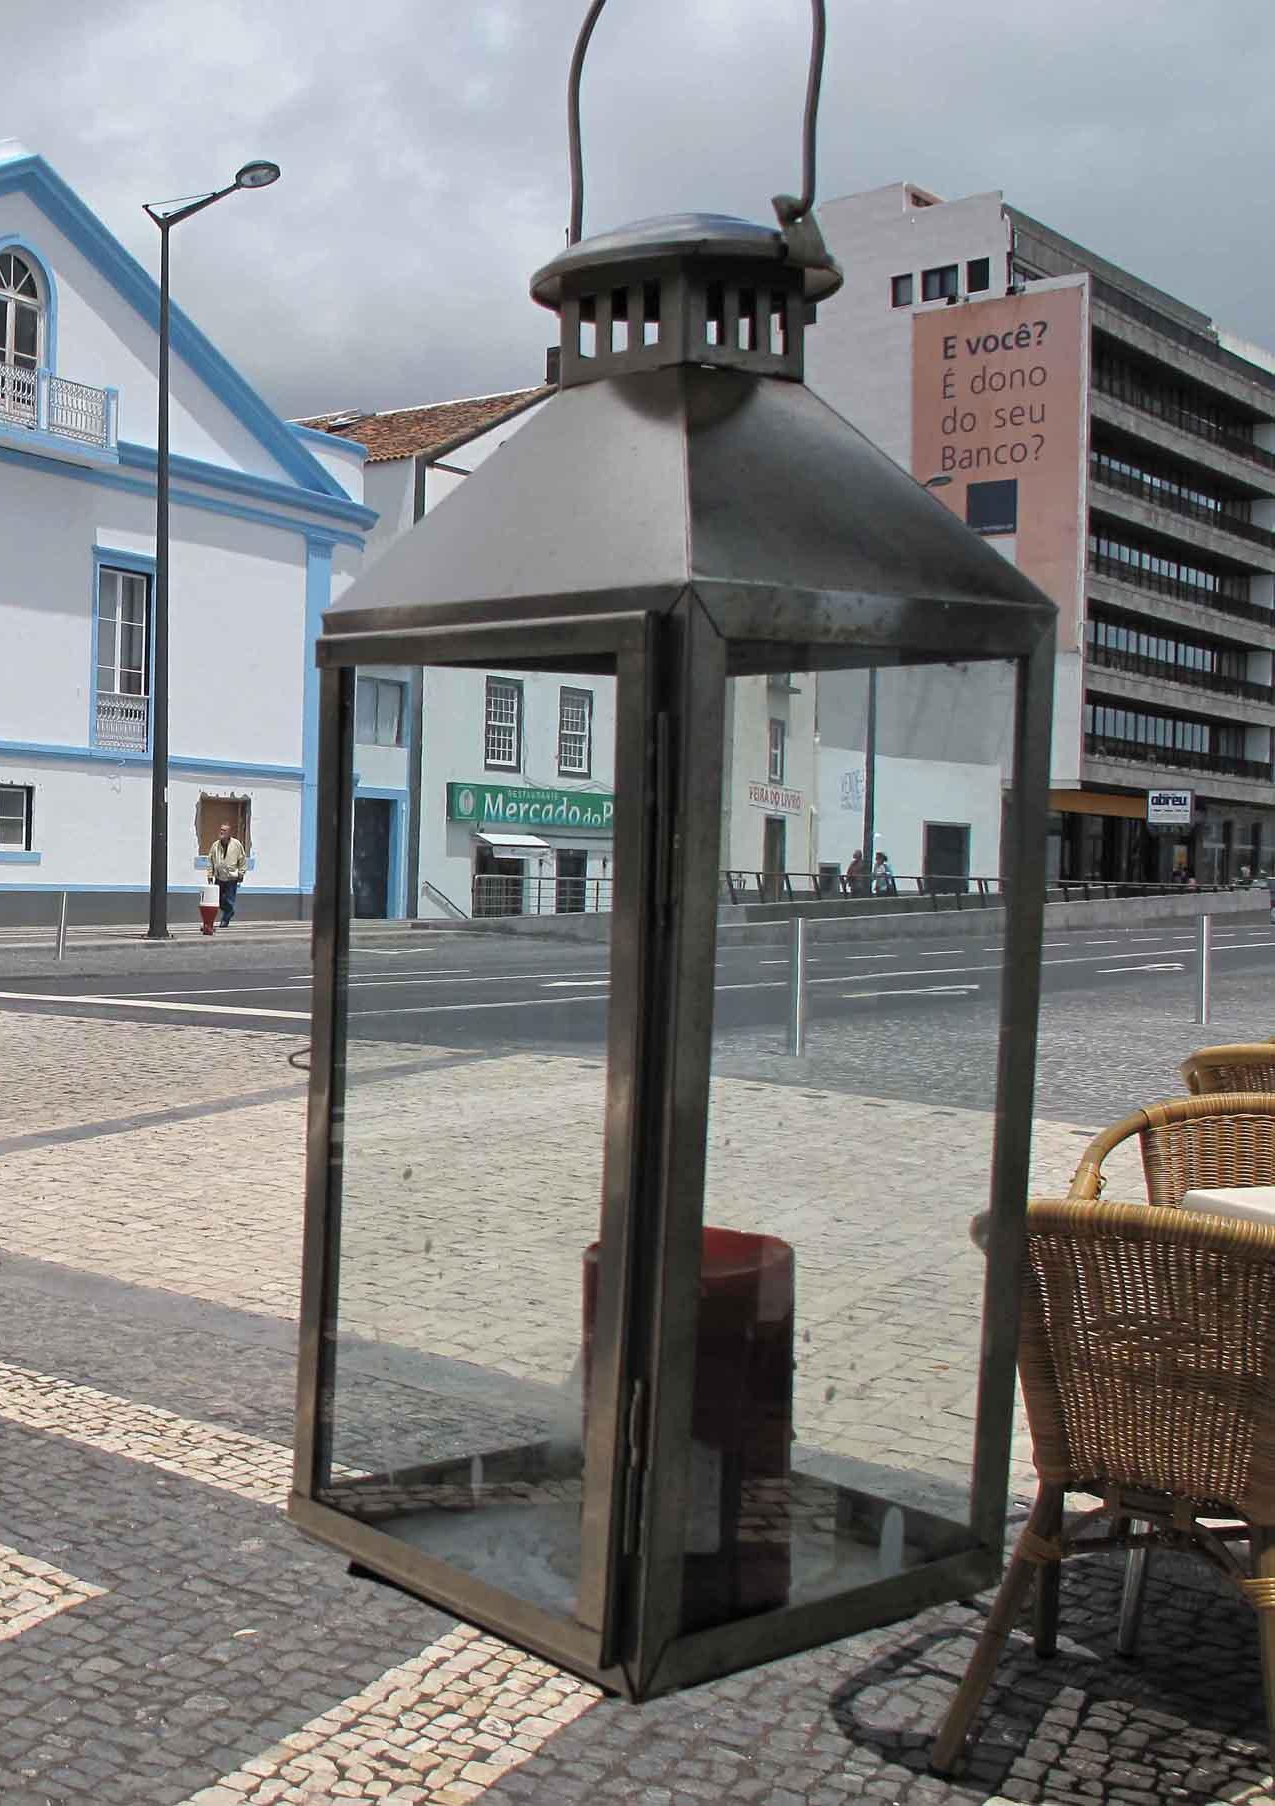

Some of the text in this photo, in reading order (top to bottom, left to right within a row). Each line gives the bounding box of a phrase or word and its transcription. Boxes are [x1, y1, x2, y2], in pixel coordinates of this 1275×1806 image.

[943, 320, 1047, 360] E você?
[942, 365, 1047, 400] É dono
[941, 403, 1045, 435] do seu
[941, 433, 1045, 472] Banco?
[484, 793, 580, 823] Mercado
[582, 807, 602, 825] do
[1151, 793, 1187, 806] abreu
